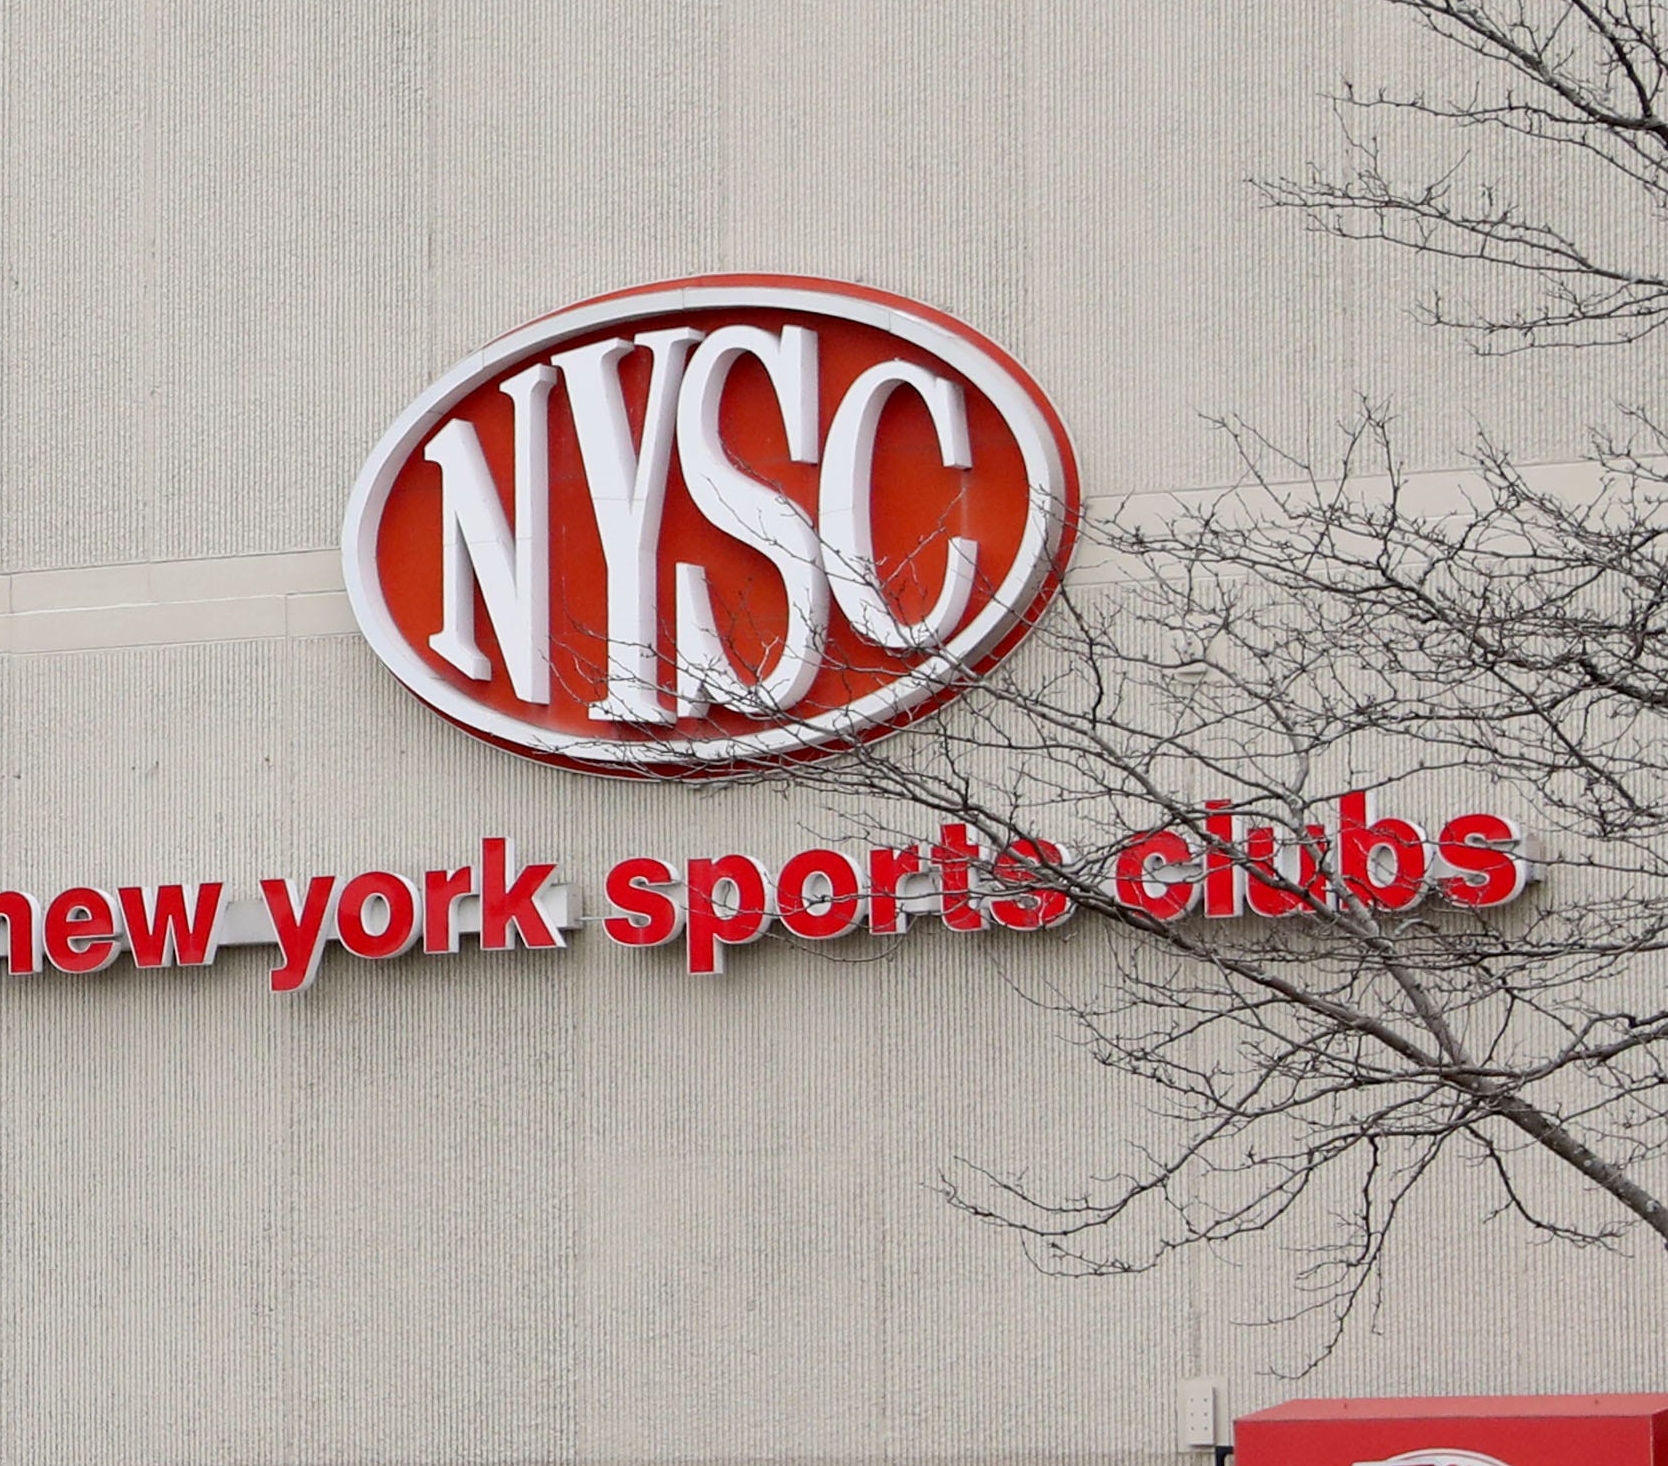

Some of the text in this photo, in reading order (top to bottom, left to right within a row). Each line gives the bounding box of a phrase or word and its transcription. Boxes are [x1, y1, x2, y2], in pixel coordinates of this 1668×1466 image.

[423, 323, 978, 727] NYSC
[259, 836, 567, 992] york
[602, 821, 1078, 975] sports
[1114, 790, 1528, 921] clubs
